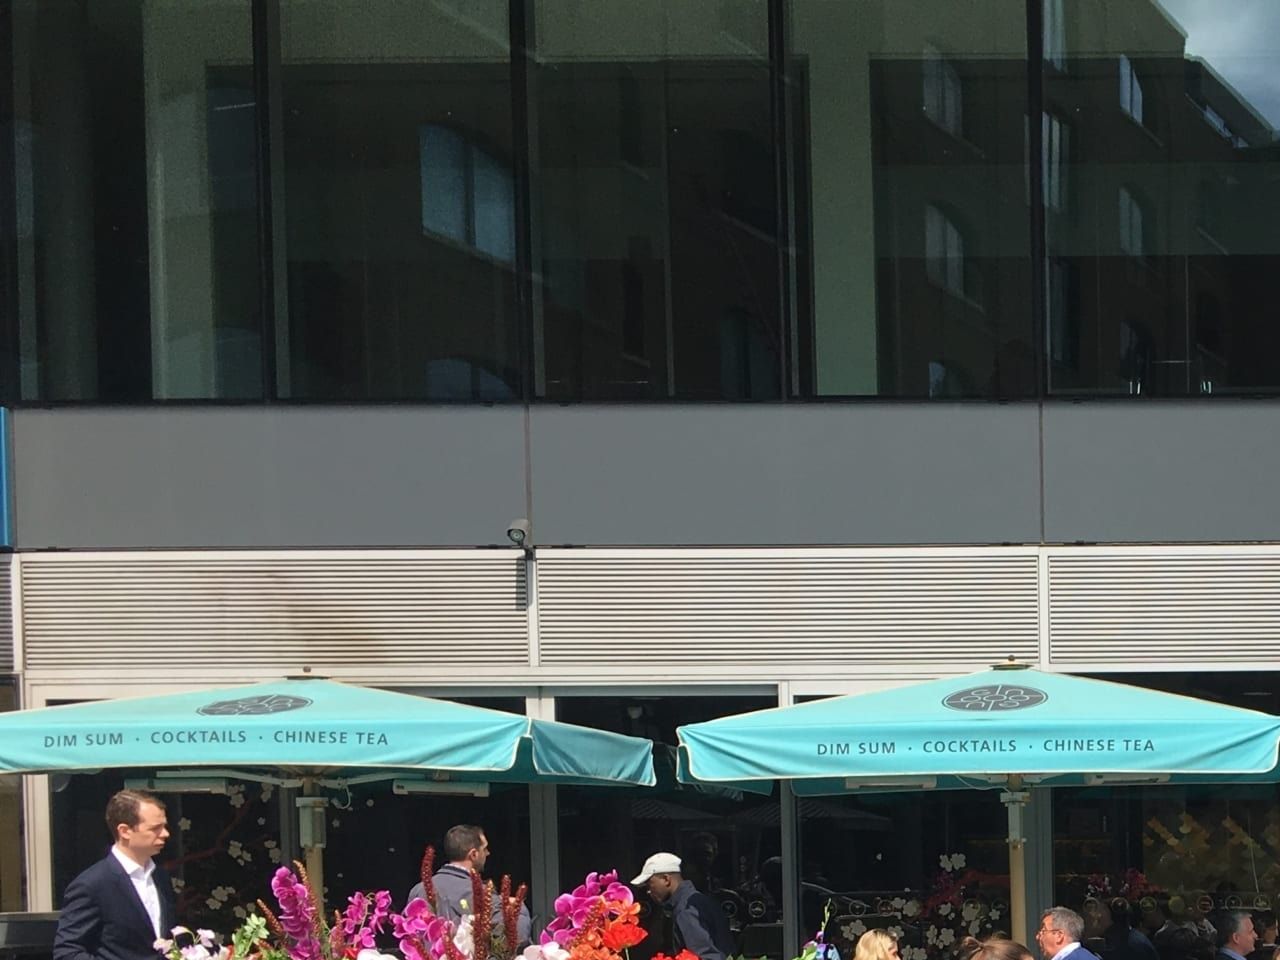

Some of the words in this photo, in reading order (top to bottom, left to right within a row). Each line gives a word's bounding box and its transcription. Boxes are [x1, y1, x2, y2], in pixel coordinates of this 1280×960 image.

[44, 734, 78, 748] DIM
[85, 732, 124, 746] SUM
[150, 730, 247, 744] COCKTAILS
[273, 730, 348, 744] CHINESE
[355, 731, 389, 746] TEA
[817, 743, 850, 755] DIM
[858, 741, 896, 754] SUM
[922, 739, 1017, 753] COCKTAILS
[1043, 739, 1115, 752] CHINESE
[1122, 739, 1155, 752] TEA
